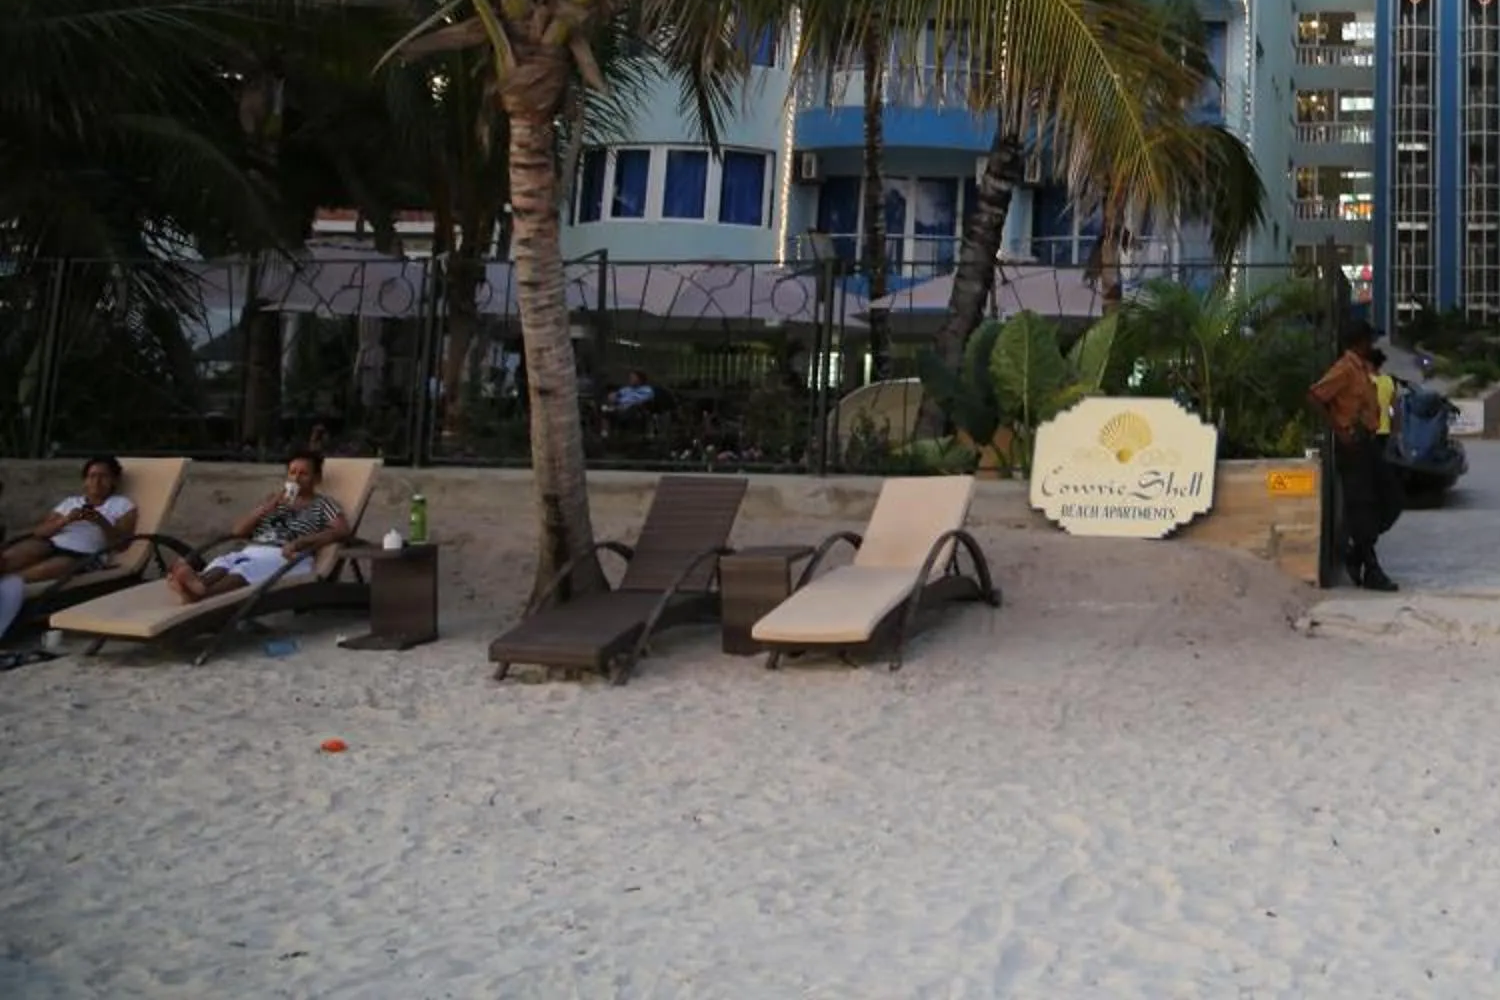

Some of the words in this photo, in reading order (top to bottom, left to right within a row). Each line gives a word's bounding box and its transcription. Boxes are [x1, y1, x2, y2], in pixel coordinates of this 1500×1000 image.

[1041, 464, 1127, 496] Cowrie
[1130, 469, 1203, 500] Shell
[1104, 504, 1177, 521] APARTMENTS
